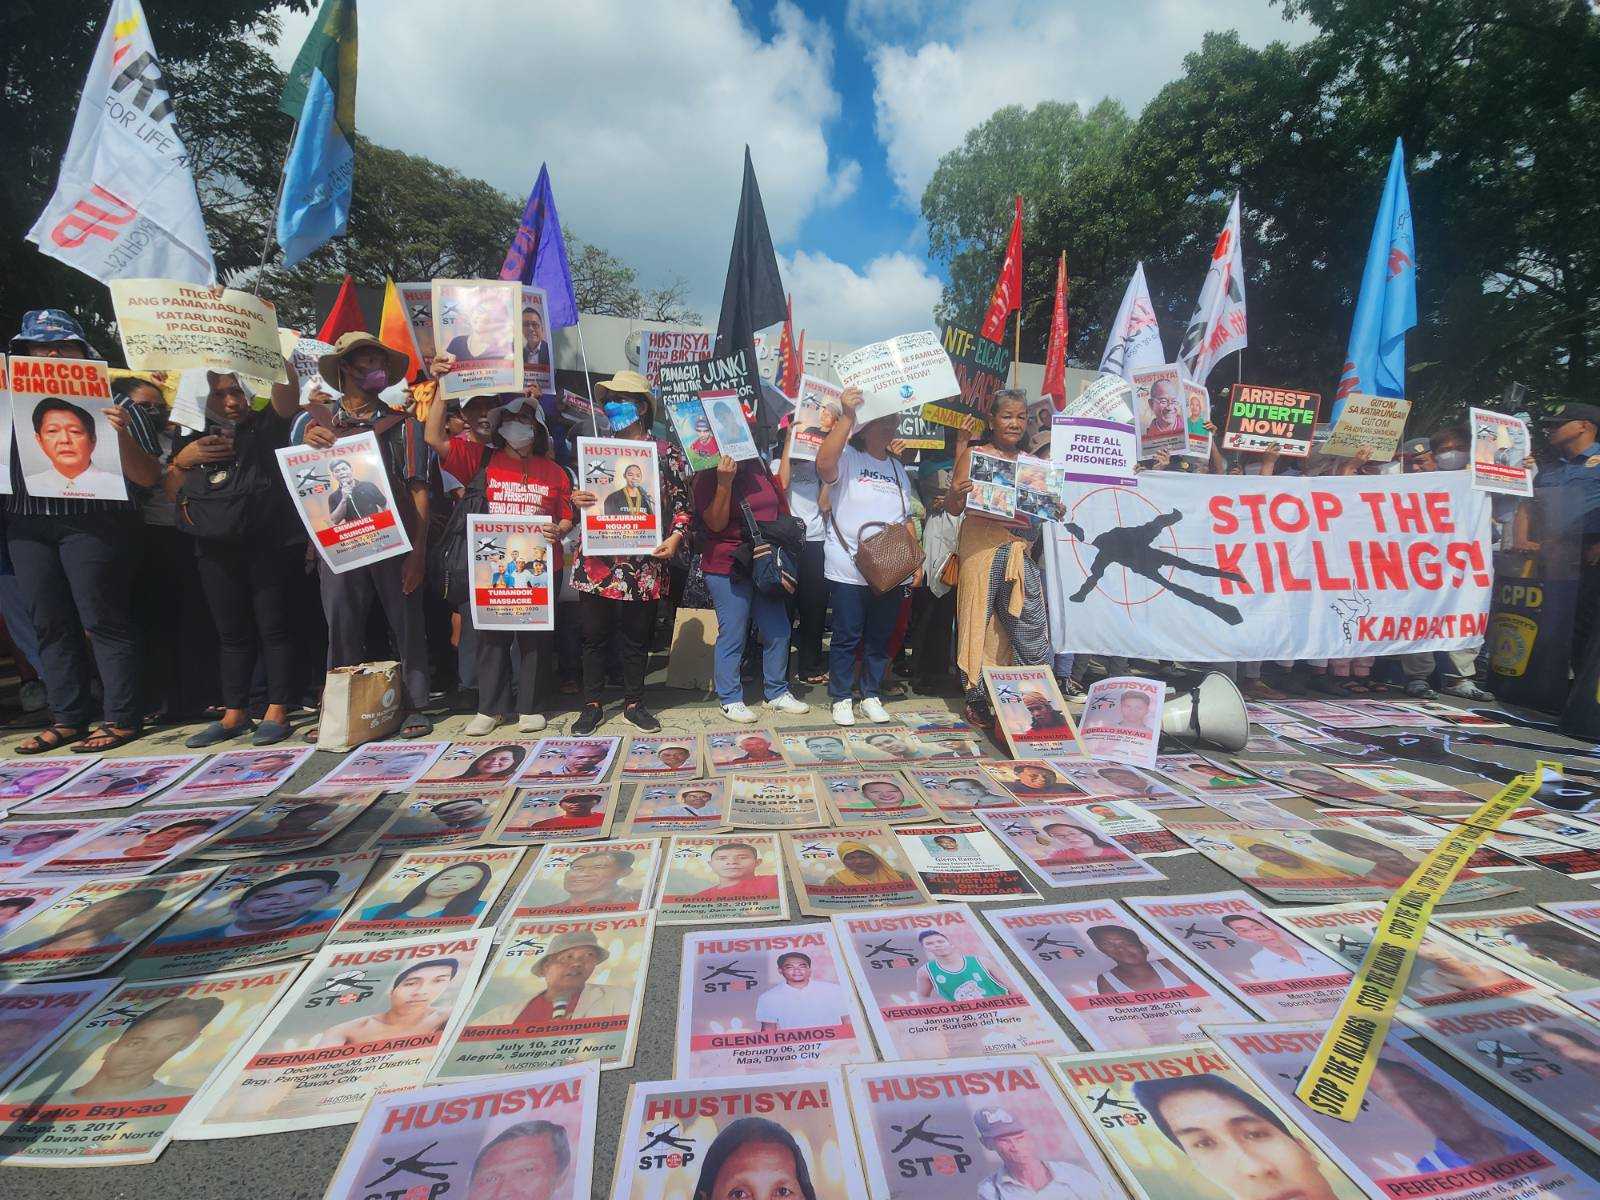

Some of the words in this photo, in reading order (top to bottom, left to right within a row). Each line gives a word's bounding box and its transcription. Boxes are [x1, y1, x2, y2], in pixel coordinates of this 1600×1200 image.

[105, 96, 136, 128] FOR
[136, 123, 175, 154] LIFE
[128, 298, 159, 306] ANG
[156, 311, 250, 330] KATARUNGAN
[167, 323, 248, 340] IPAGLABAN!
[649, 333, 710, 350] HUSTISYA
[14, 362, 98, 381] MARCOS
[704, 350, 748, 383] JUNK!
[13, 377, 111, 398] SINGILIN!
[873, 376, 905, 393] JUSTICE
[906, 370, 932, 382] NOW!
[1240, 388, 1310, 408] ARREST
[1233, 403, 1315, 424] DUTERTE
[1240, 419, 1295, 438] NOW!
[1070, 443, 1124, 457] POLITICAL
[1074, 434, 1101, 445] FREE
[1103, 437, 1121, 448] ALL
[585, 446, 652, 458] HUSTISYA!
[1065, 454, 1127, 467] PRISONERS!
[1208, 491, 1343, 534] STOP
[1360, 491, 1456, 534] THE
[339, 525, 376, 541] ASUNCION
[1214, 540, 1491, 595] KILLINGS!
[990, 672, 1047, 681] HUSTISYA!
[1093, 681, 1158, 693] HUSTISYA!
[677, 837, 774, 847] HUSTISYA!
[792, 829, 883, 841] HUSTISYA!
[551, 842, 651, 855] HUSTISYA!
[802, 852, 836, 860] STOP
[407, 852, 516, 866] HUSTISYA!
[1143, 900, 1255, 918] HUSTISYA!
[517, 917, 648, 937] HUSTISYA!
[848, 911, 967, 934] HUSTISYA!
[1002, 907, 1117, 930] HUSTISYA!
[329, 938, 479, 968] HUSTISYA!
[505, 949, 545, 957] STOP
[697, 933, 825, 955] HUSTISYA!
[871, 957, 919, 970] STOP
[1038, 948, 1086, 962] STOP
[704, 980, 758, 993] STOP
[1136, 988, 1191, 1003] OTACAN
[304, 990, 374, 1009] STOP
[1356, 984, 1390, 1013] STOP
[883, 1004, 949, 1019] VERONICO
[951, 997, 1027, 1013] DELAMENTE
[1108, 1013, 1142, 1023] Boston,
[1142, 1011, 1167, 1020] Davao
[1166, 1007, 1204, 1018] Oriental
[1114, 1006, 1149, 1015] October
[1162, 1001, 1183, 1010] 2017
[924, 1015, 961, 1026] January
[963, 1014, 979, 1023] 20,
[980, 1011, 999, 1020] 2017
[942, 1021, 975, 1032] Surigao
[978, 1019, 994, 1028] del
[995, 1016, 1022, 1026] Norte
[1424, 1004, 1560, 1037] HUSTISYA!
[461, 1025, 520, 1038] Meliton
[525, 1019, 629, 1035] Catampungan
[496, 1042, 525, 1052] July
[528, 1041, 547, 1051] 10,
[550, 1038, 582, 1048] 2017
[711, 1033, 771, 1048] GLENN
[774, 1029, 836, 1043] RAMOS
[1333, 1015, 1377, 1064] KILLINGS
[255, 1047, 357, 1067] BERNARDO
[357, 1036, 437, 1055] CLARION
[457, 1051, 507, 1063] Alegria,
[509, 1049, 558, 1060] Surigao
[560, 1045, 580, 1056] del
[582, 1043, 617, 1054] Norte
[732, 1045, 779, 1057] February
[780, 1044, 796, 1055] 06,
[798, 1043, 822, 1052] 2017
[765, 1053, 798, 1063] Davao
[800, 1051, 821, 1062] City
[282, 1061, 345, 1076] December
[363, 1053, 394, 1064] 2017
[1067, 1053, 1232, 1088] HUSTISYA!
[1322, 1054, 1360, 1086] THE
[296, 1078, 336, 1090] Davao
[337, 1075, 362, 1086] City
[868, 1068, 1041, 1103] HUSTISYA!
[646, 1088, 829, 1122] HUSTISYA!
[1309, 1077, 1349, 1115] STOP
[381, 1078, 583, 1135] HUSTISYA!
[65, 1124, 78, 1134] 5,
[87, 1121, 129, 1132] 2017
[1100, 1112, 1148, 1130] STOP
[43, 1134, 90, 1143] Davao
[92, 1132, 116, 1142] del
[119, 1131, 165, 1140] Norte
[638, 1152, 695, 1170] STOP
[897, 1153, 972, 1179] STOP
[1387, 1169, 1485, 1197] PERFECTO
[1486, 1153, 1543, 1181] MOYLE
[1508, 1175, 1533, 1190] 2017
